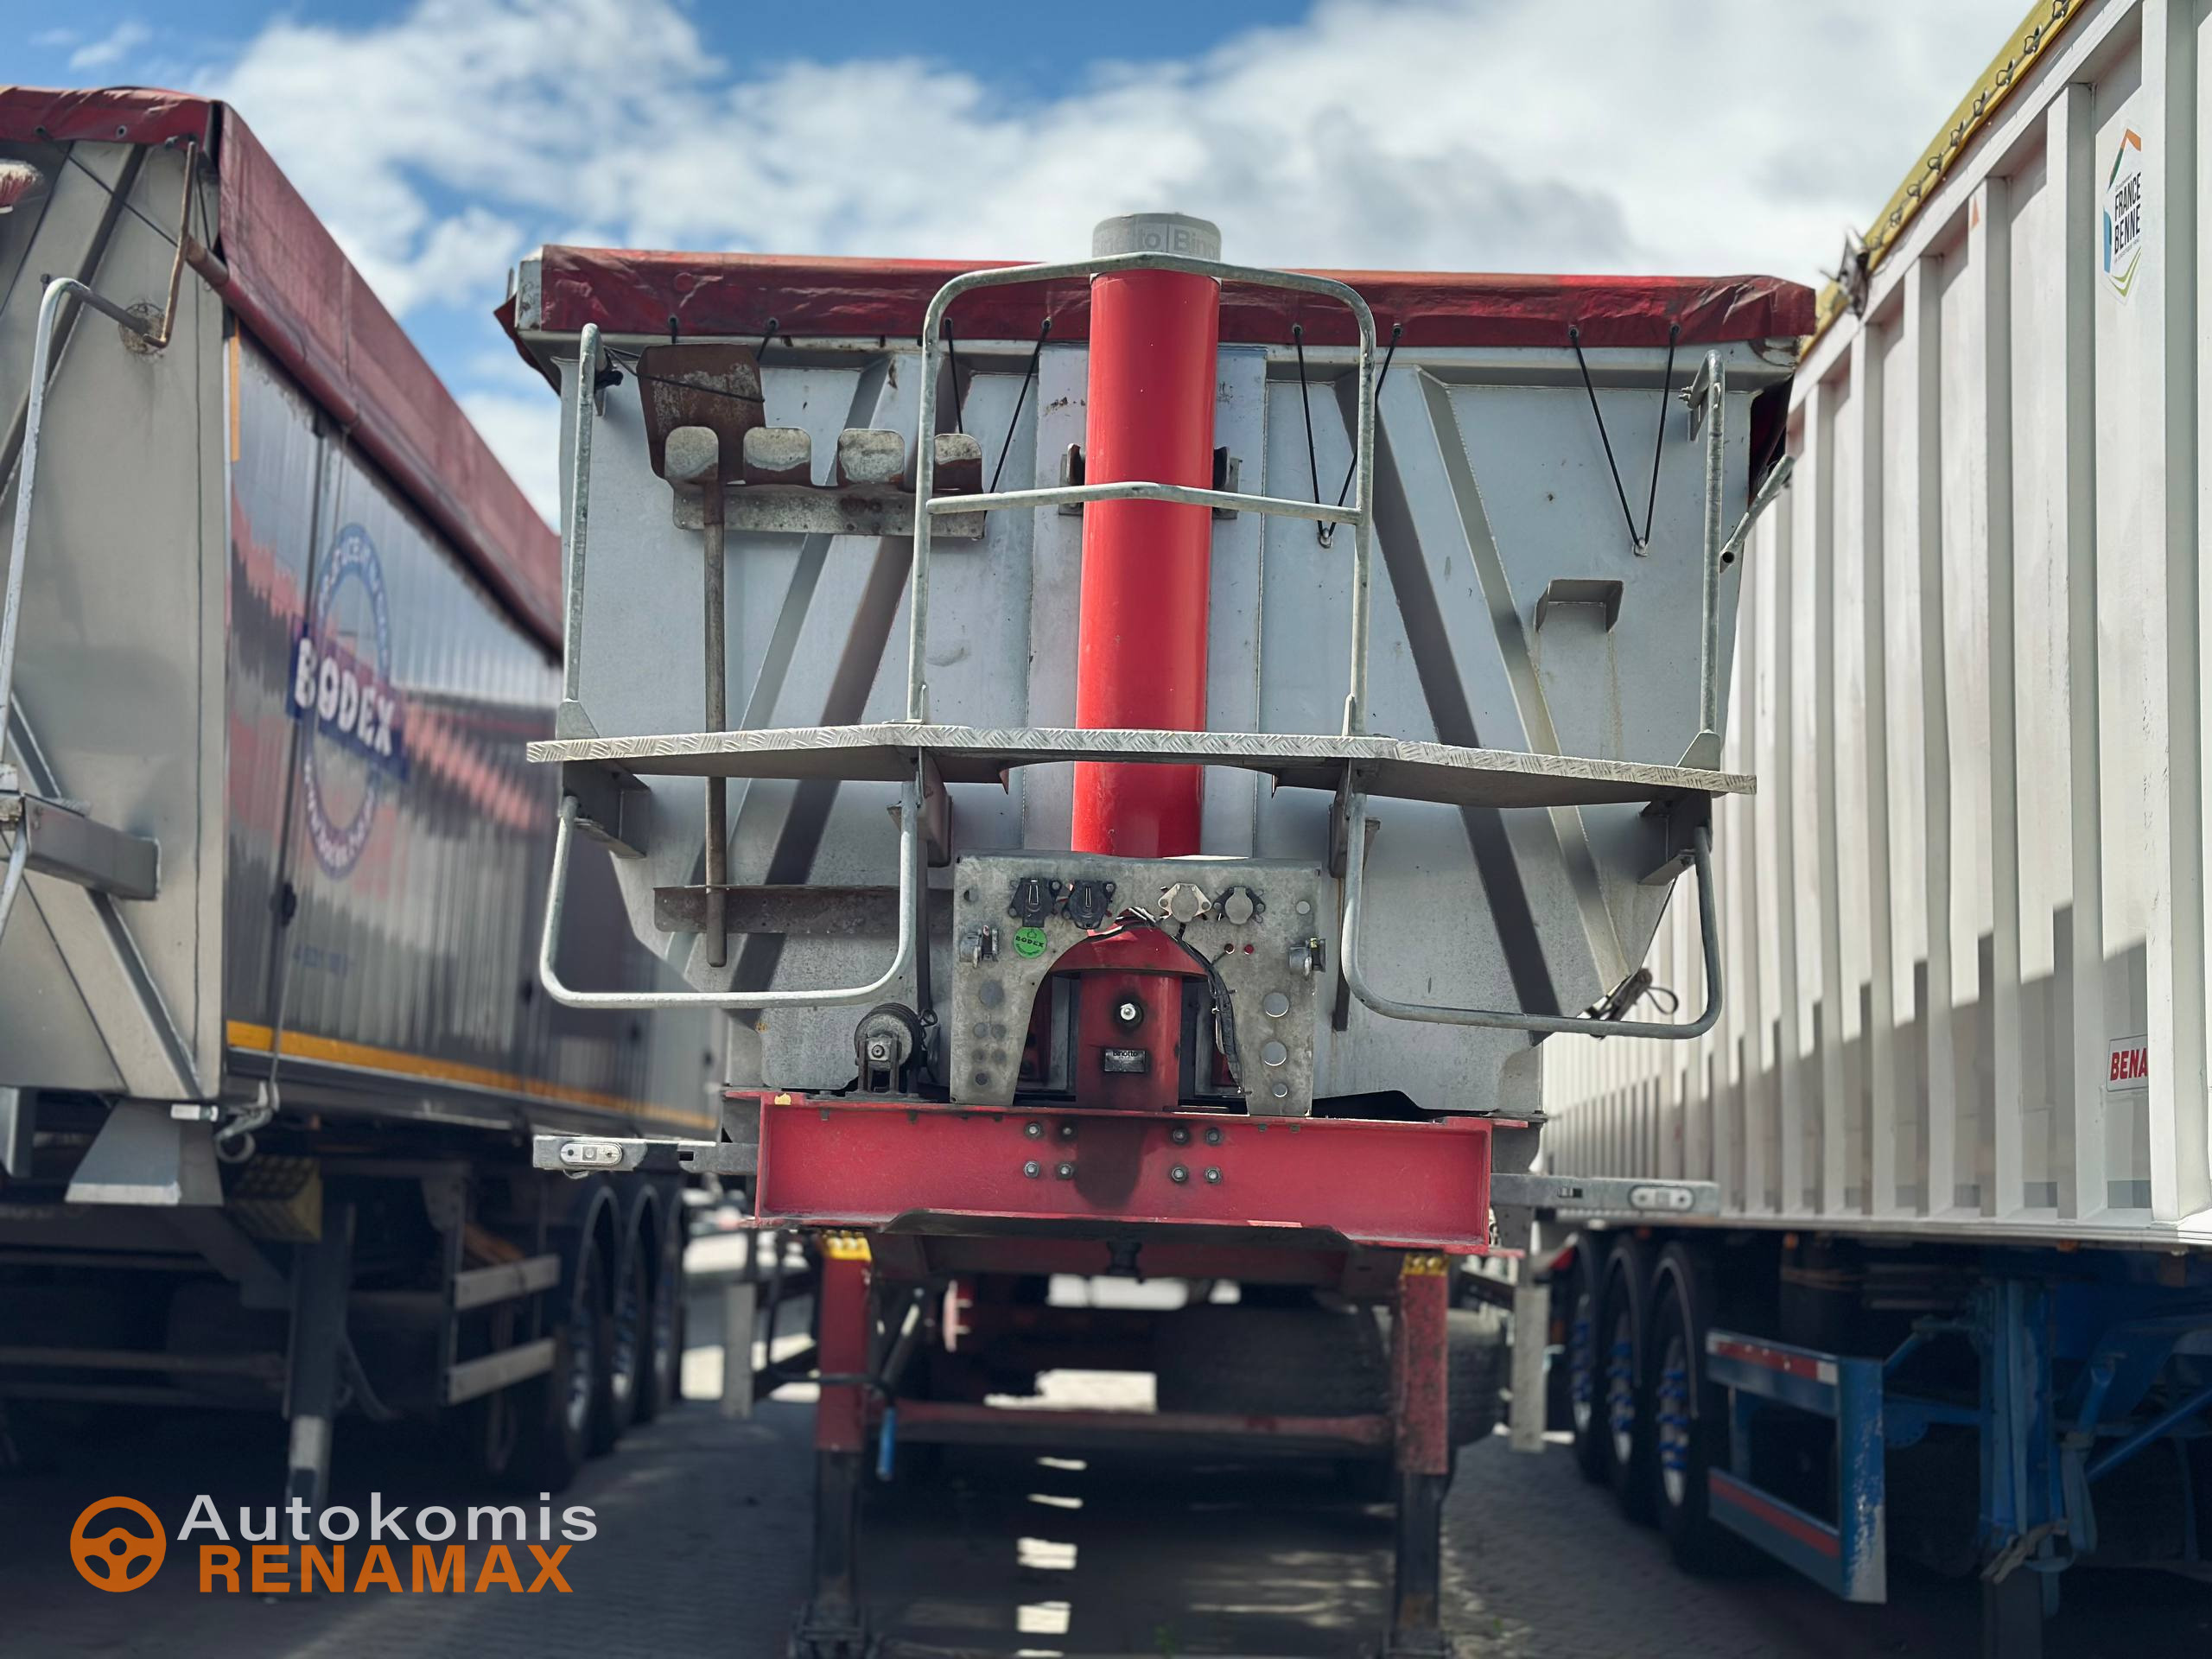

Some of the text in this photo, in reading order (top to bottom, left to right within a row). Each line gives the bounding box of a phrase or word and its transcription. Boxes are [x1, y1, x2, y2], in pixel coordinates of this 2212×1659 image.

[2114, 172, 2141, 221] FRANCE
[2114, 203, 2140, 255] BENNE
[295, 638, 395, 756] BODEX
[1015, 935, 1045, 948] BODEX
[2110, 1047, 2149, 1081] BENA
